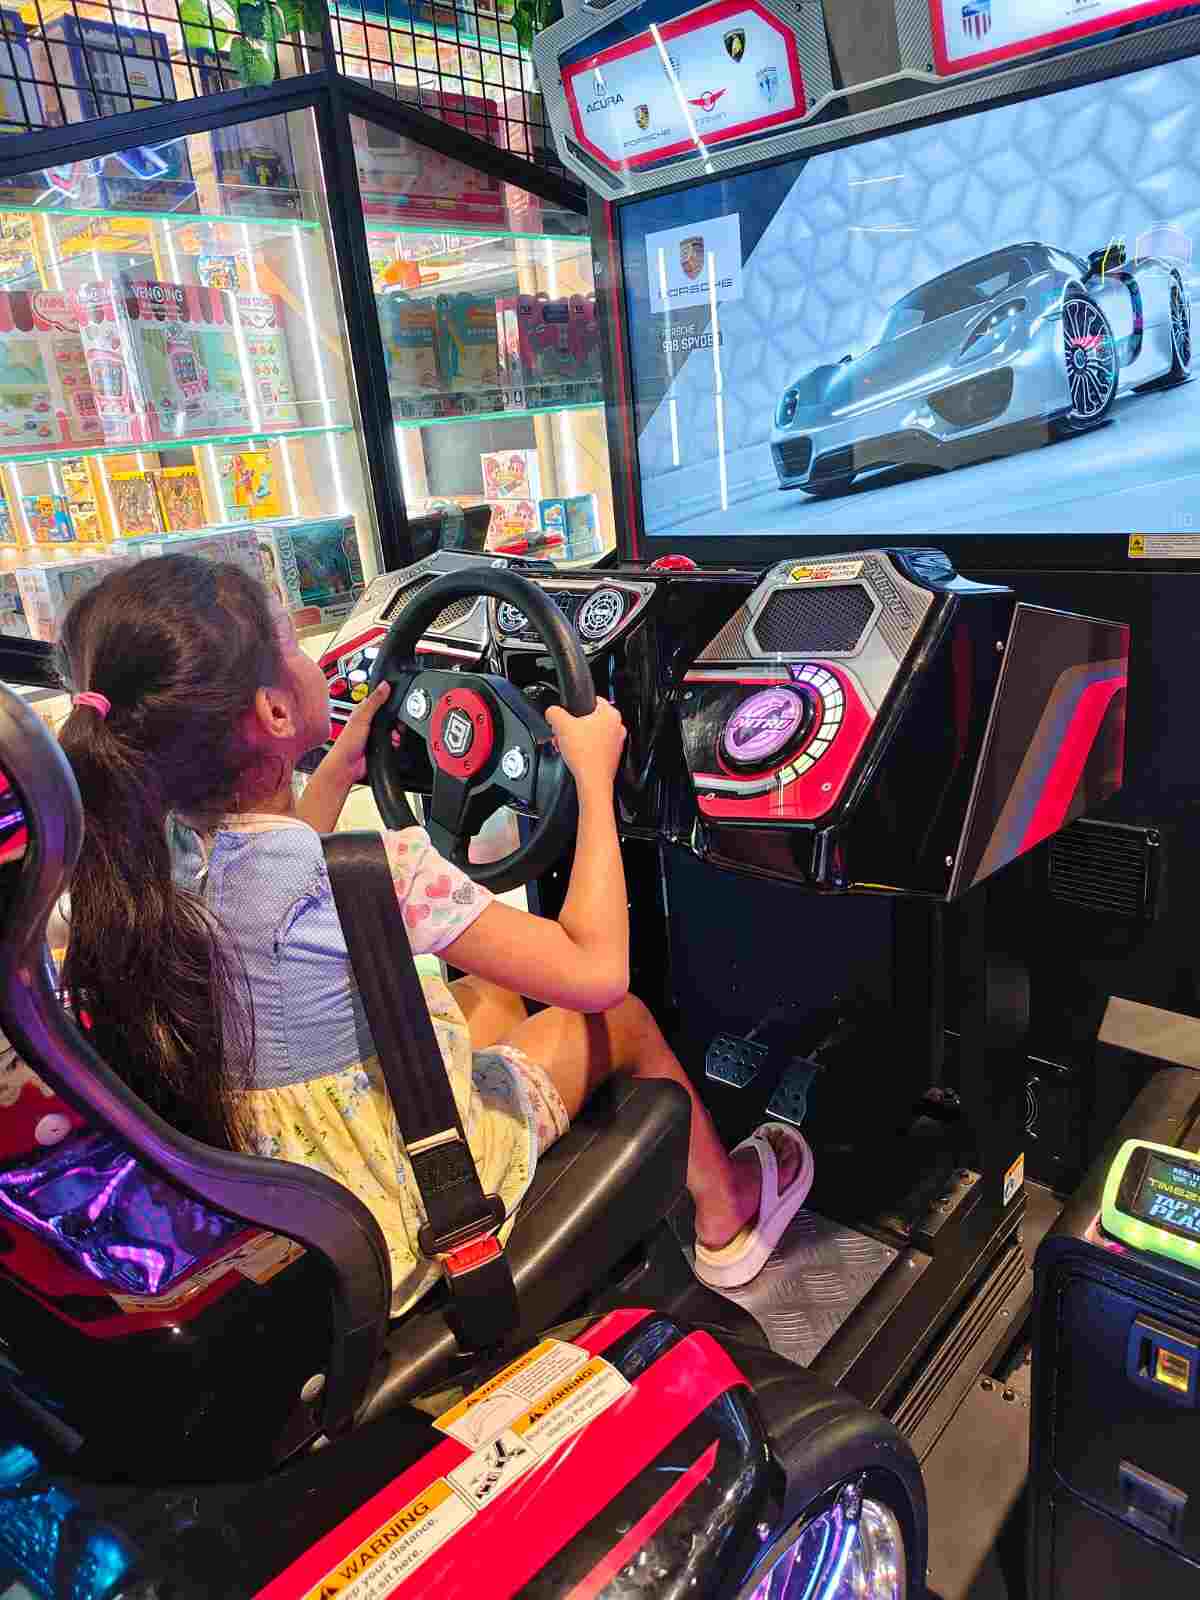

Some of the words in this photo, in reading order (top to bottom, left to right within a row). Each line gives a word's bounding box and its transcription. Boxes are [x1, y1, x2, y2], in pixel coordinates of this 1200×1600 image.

[586, 93, 624, 113] ACURA
[681, 331, 723, 350] SPYDE
[339, 1502, 430, 1580] WARNING
